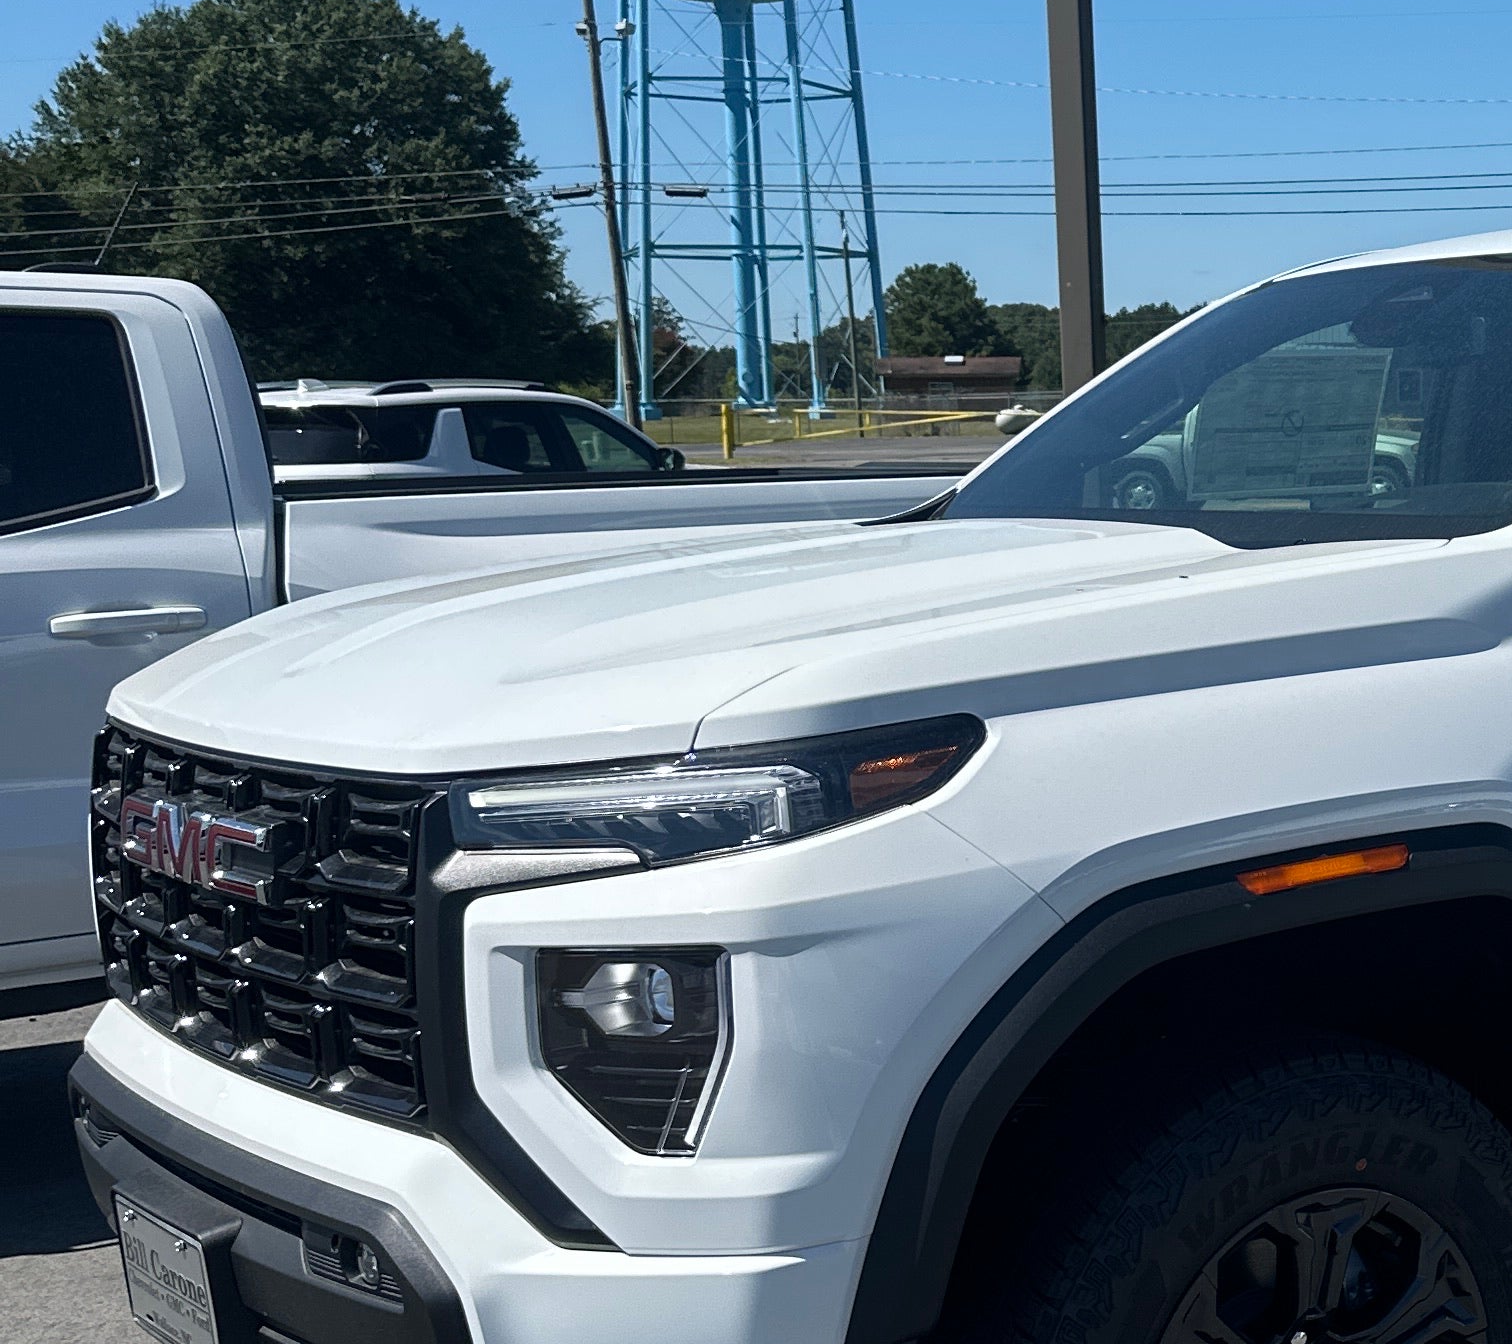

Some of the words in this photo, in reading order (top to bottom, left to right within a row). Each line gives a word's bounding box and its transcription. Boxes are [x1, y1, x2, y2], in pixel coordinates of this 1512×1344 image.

[121, 797, 271, 906] GMC
[123, 1229, 150, 1273] Bill
[150, 1249, 207, 1308] Carone
